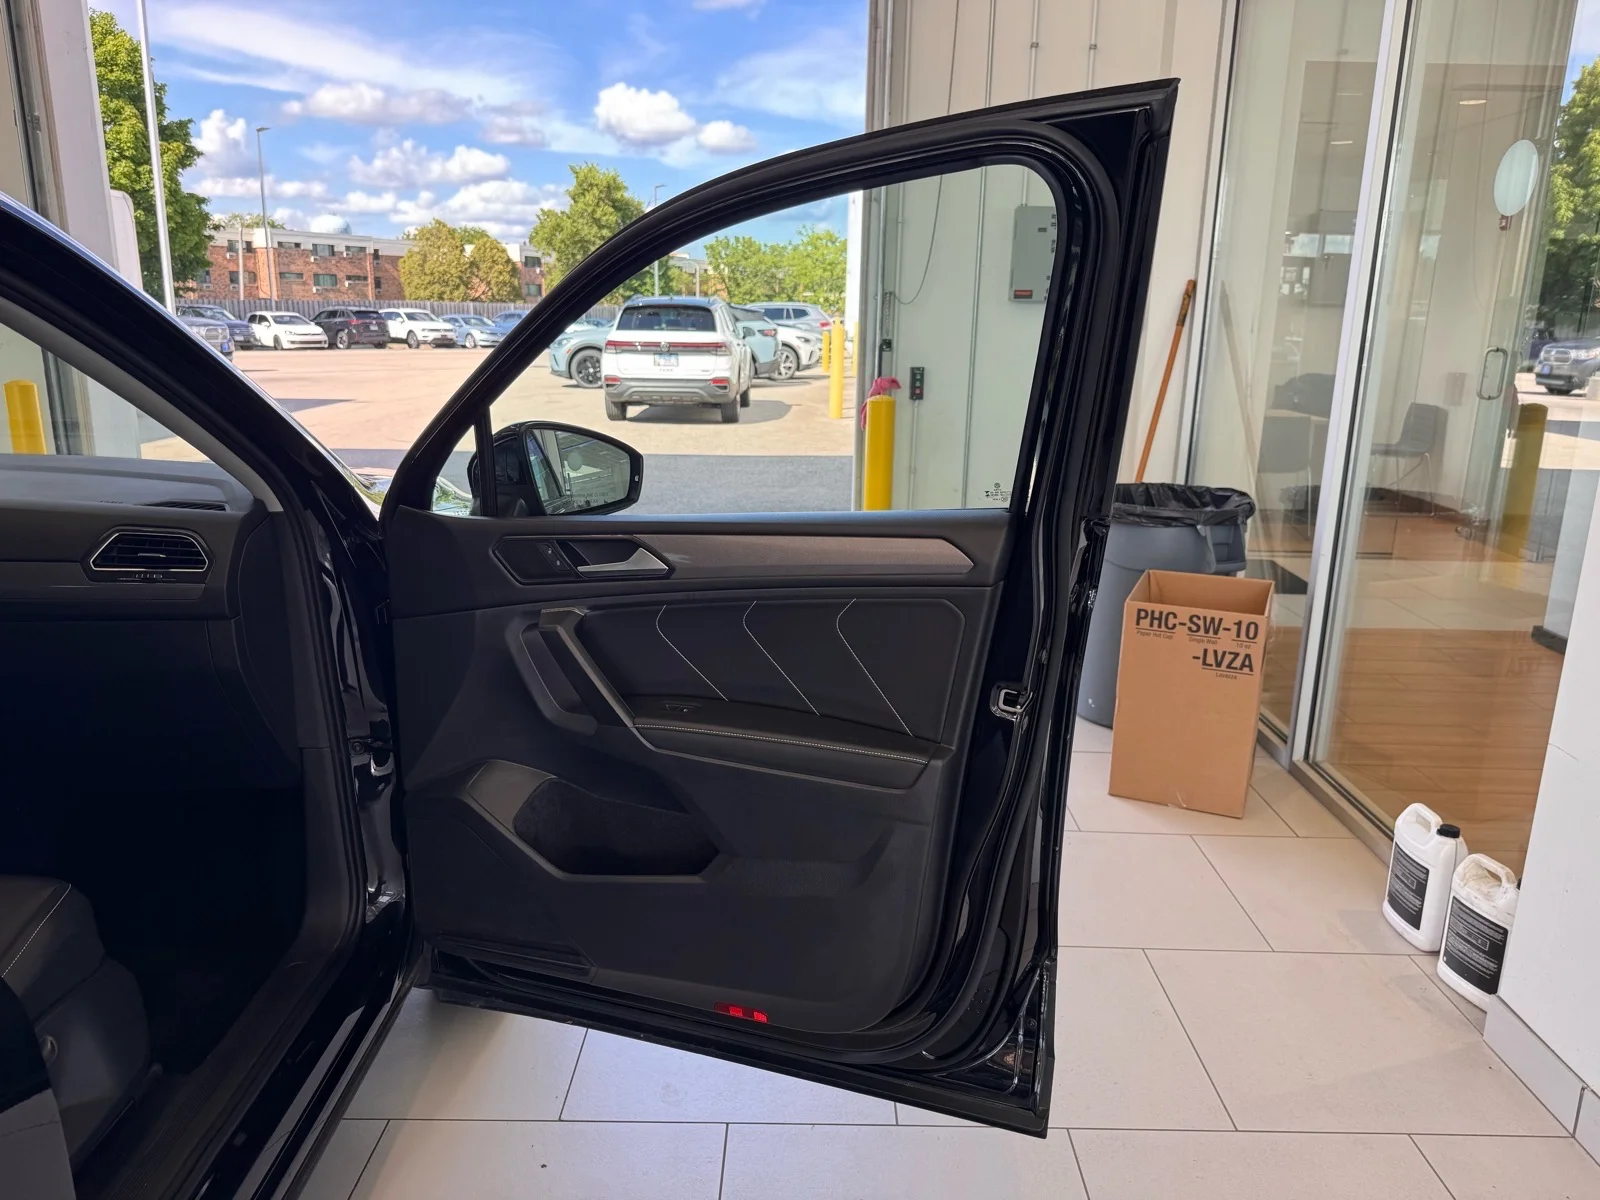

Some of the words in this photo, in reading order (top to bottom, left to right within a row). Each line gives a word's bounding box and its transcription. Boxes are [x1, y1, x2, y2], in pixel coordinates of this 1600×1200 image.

[1135, 608, 1259, 641] PHC-SW-10
[1136, 630, 1152, 638] Paper
[1192, 648, 1254, 673] -LVZA
